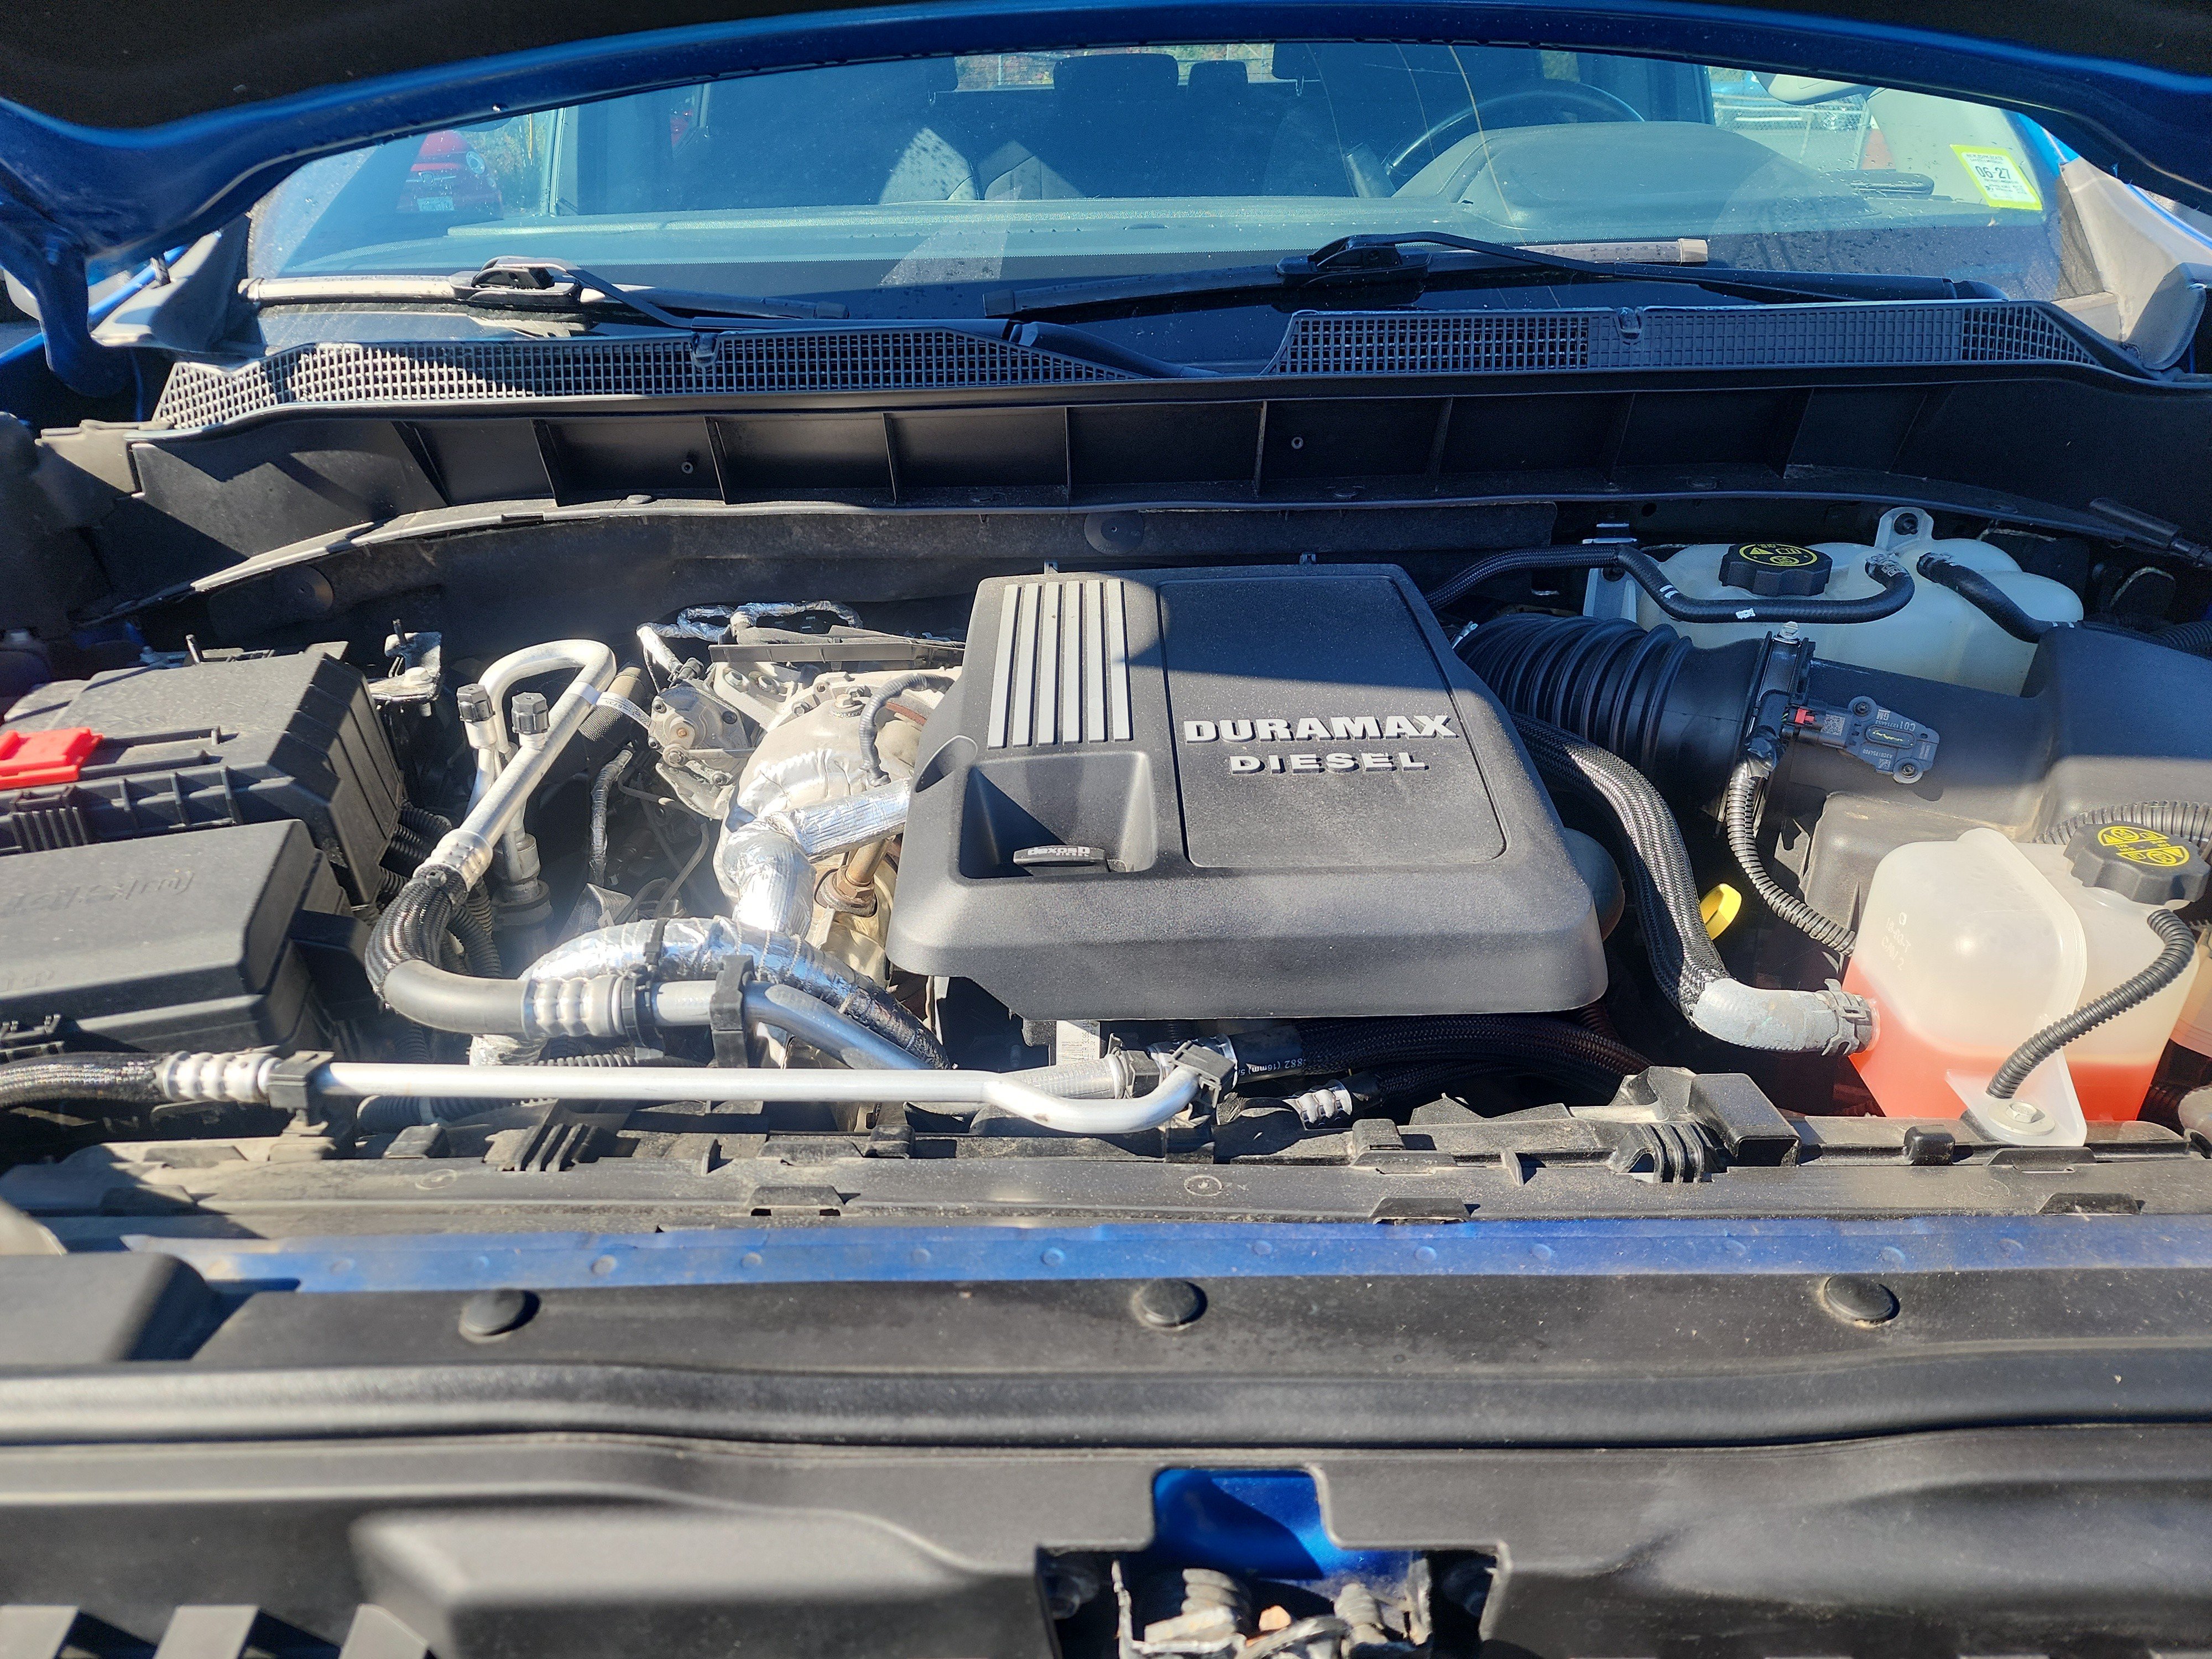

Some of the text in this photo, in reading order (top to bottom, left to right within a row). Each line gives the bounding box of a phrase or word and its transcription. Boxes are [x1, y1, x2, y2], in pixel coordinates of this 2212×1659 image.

[1975, 166, 2011, 179] 06-27
[1876, 711, 1890, 721] GM
[1183, 715, 1458, 743] DURAMAX
[1229, 752, 1428, 774] DIESEL
[1248, 1061, 1281, 1074] (16mm)
